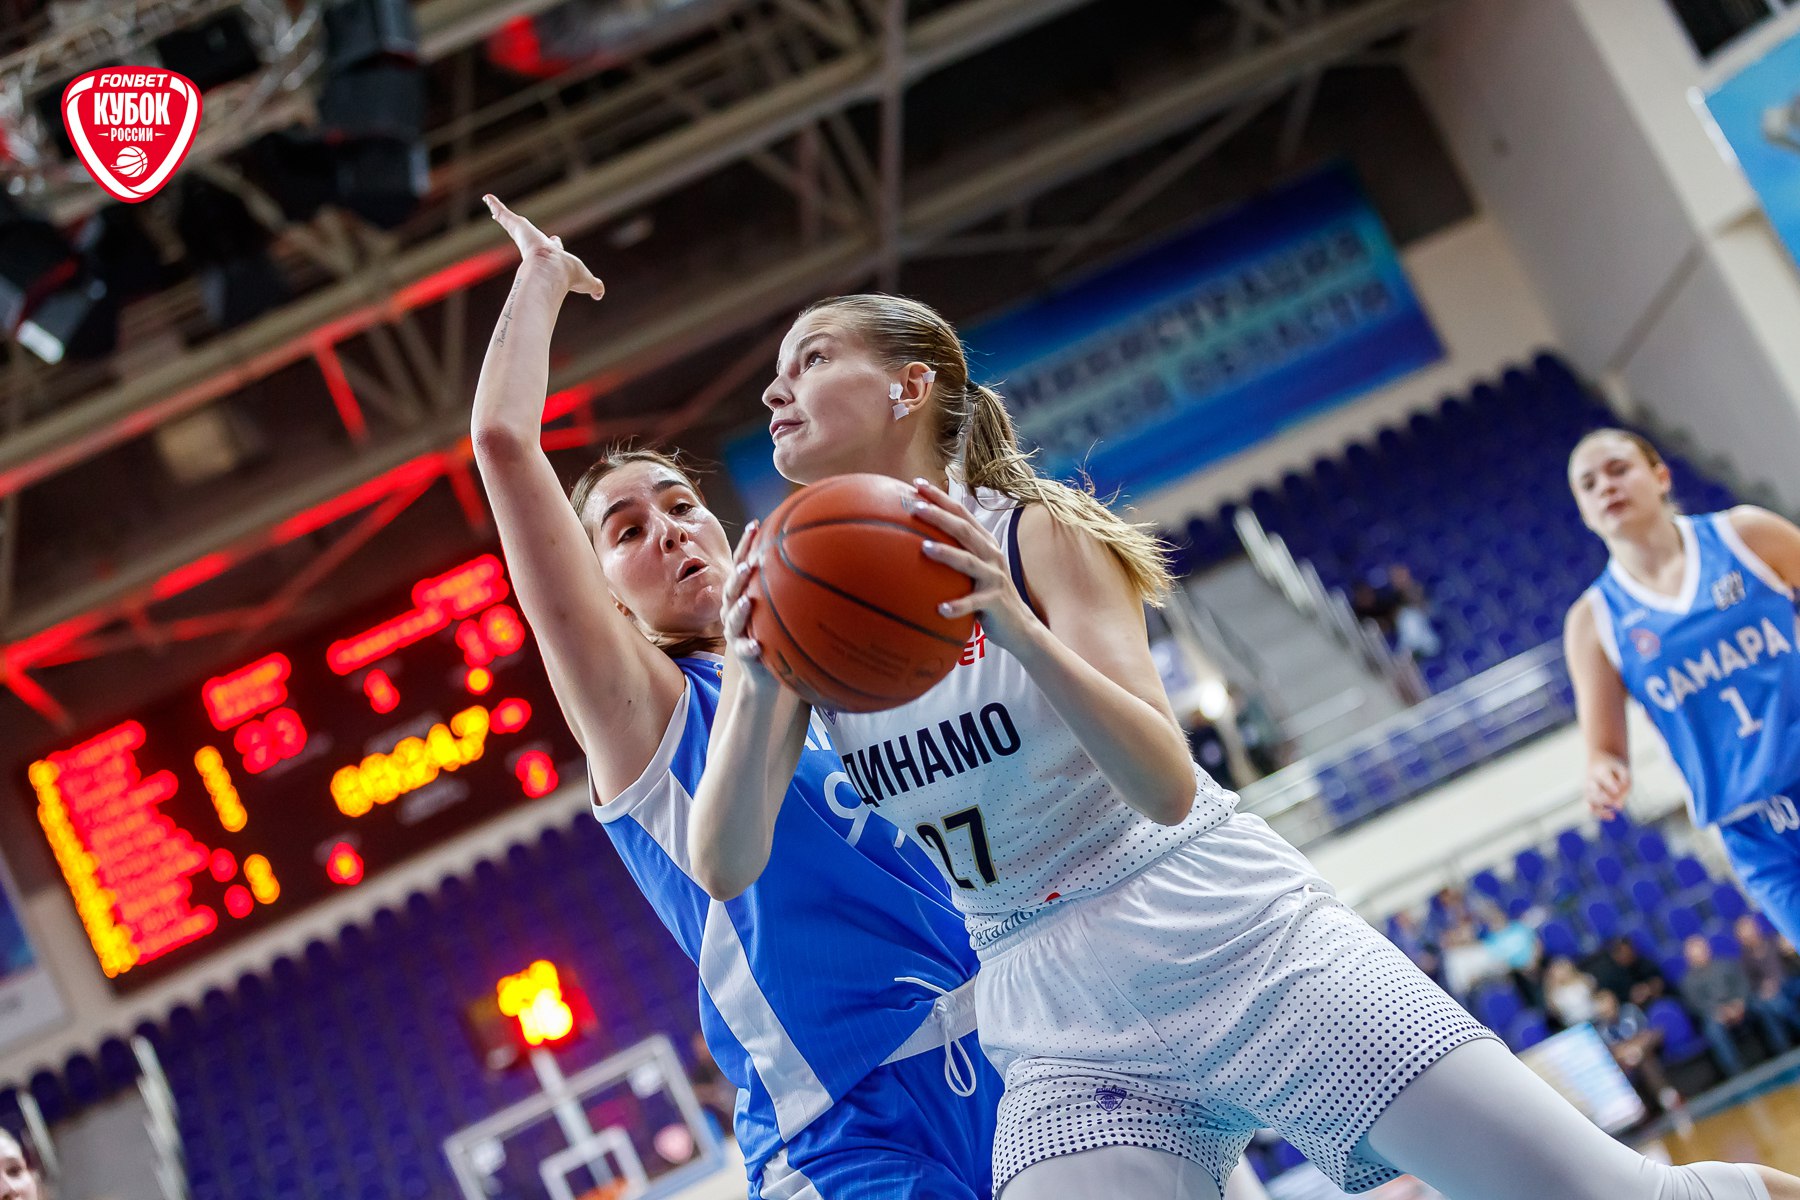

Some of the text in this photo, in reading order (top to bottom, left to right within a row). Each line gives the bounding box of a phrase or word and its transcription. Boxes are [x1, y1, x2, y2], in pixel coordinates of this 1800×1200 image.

[1646, 618, 1792, 711] САМАРА
[842, 702, 1022, 808] ДИНАМО
[1719, 687, 1763, 738] 1
[915, 803, 999, 891] 27
